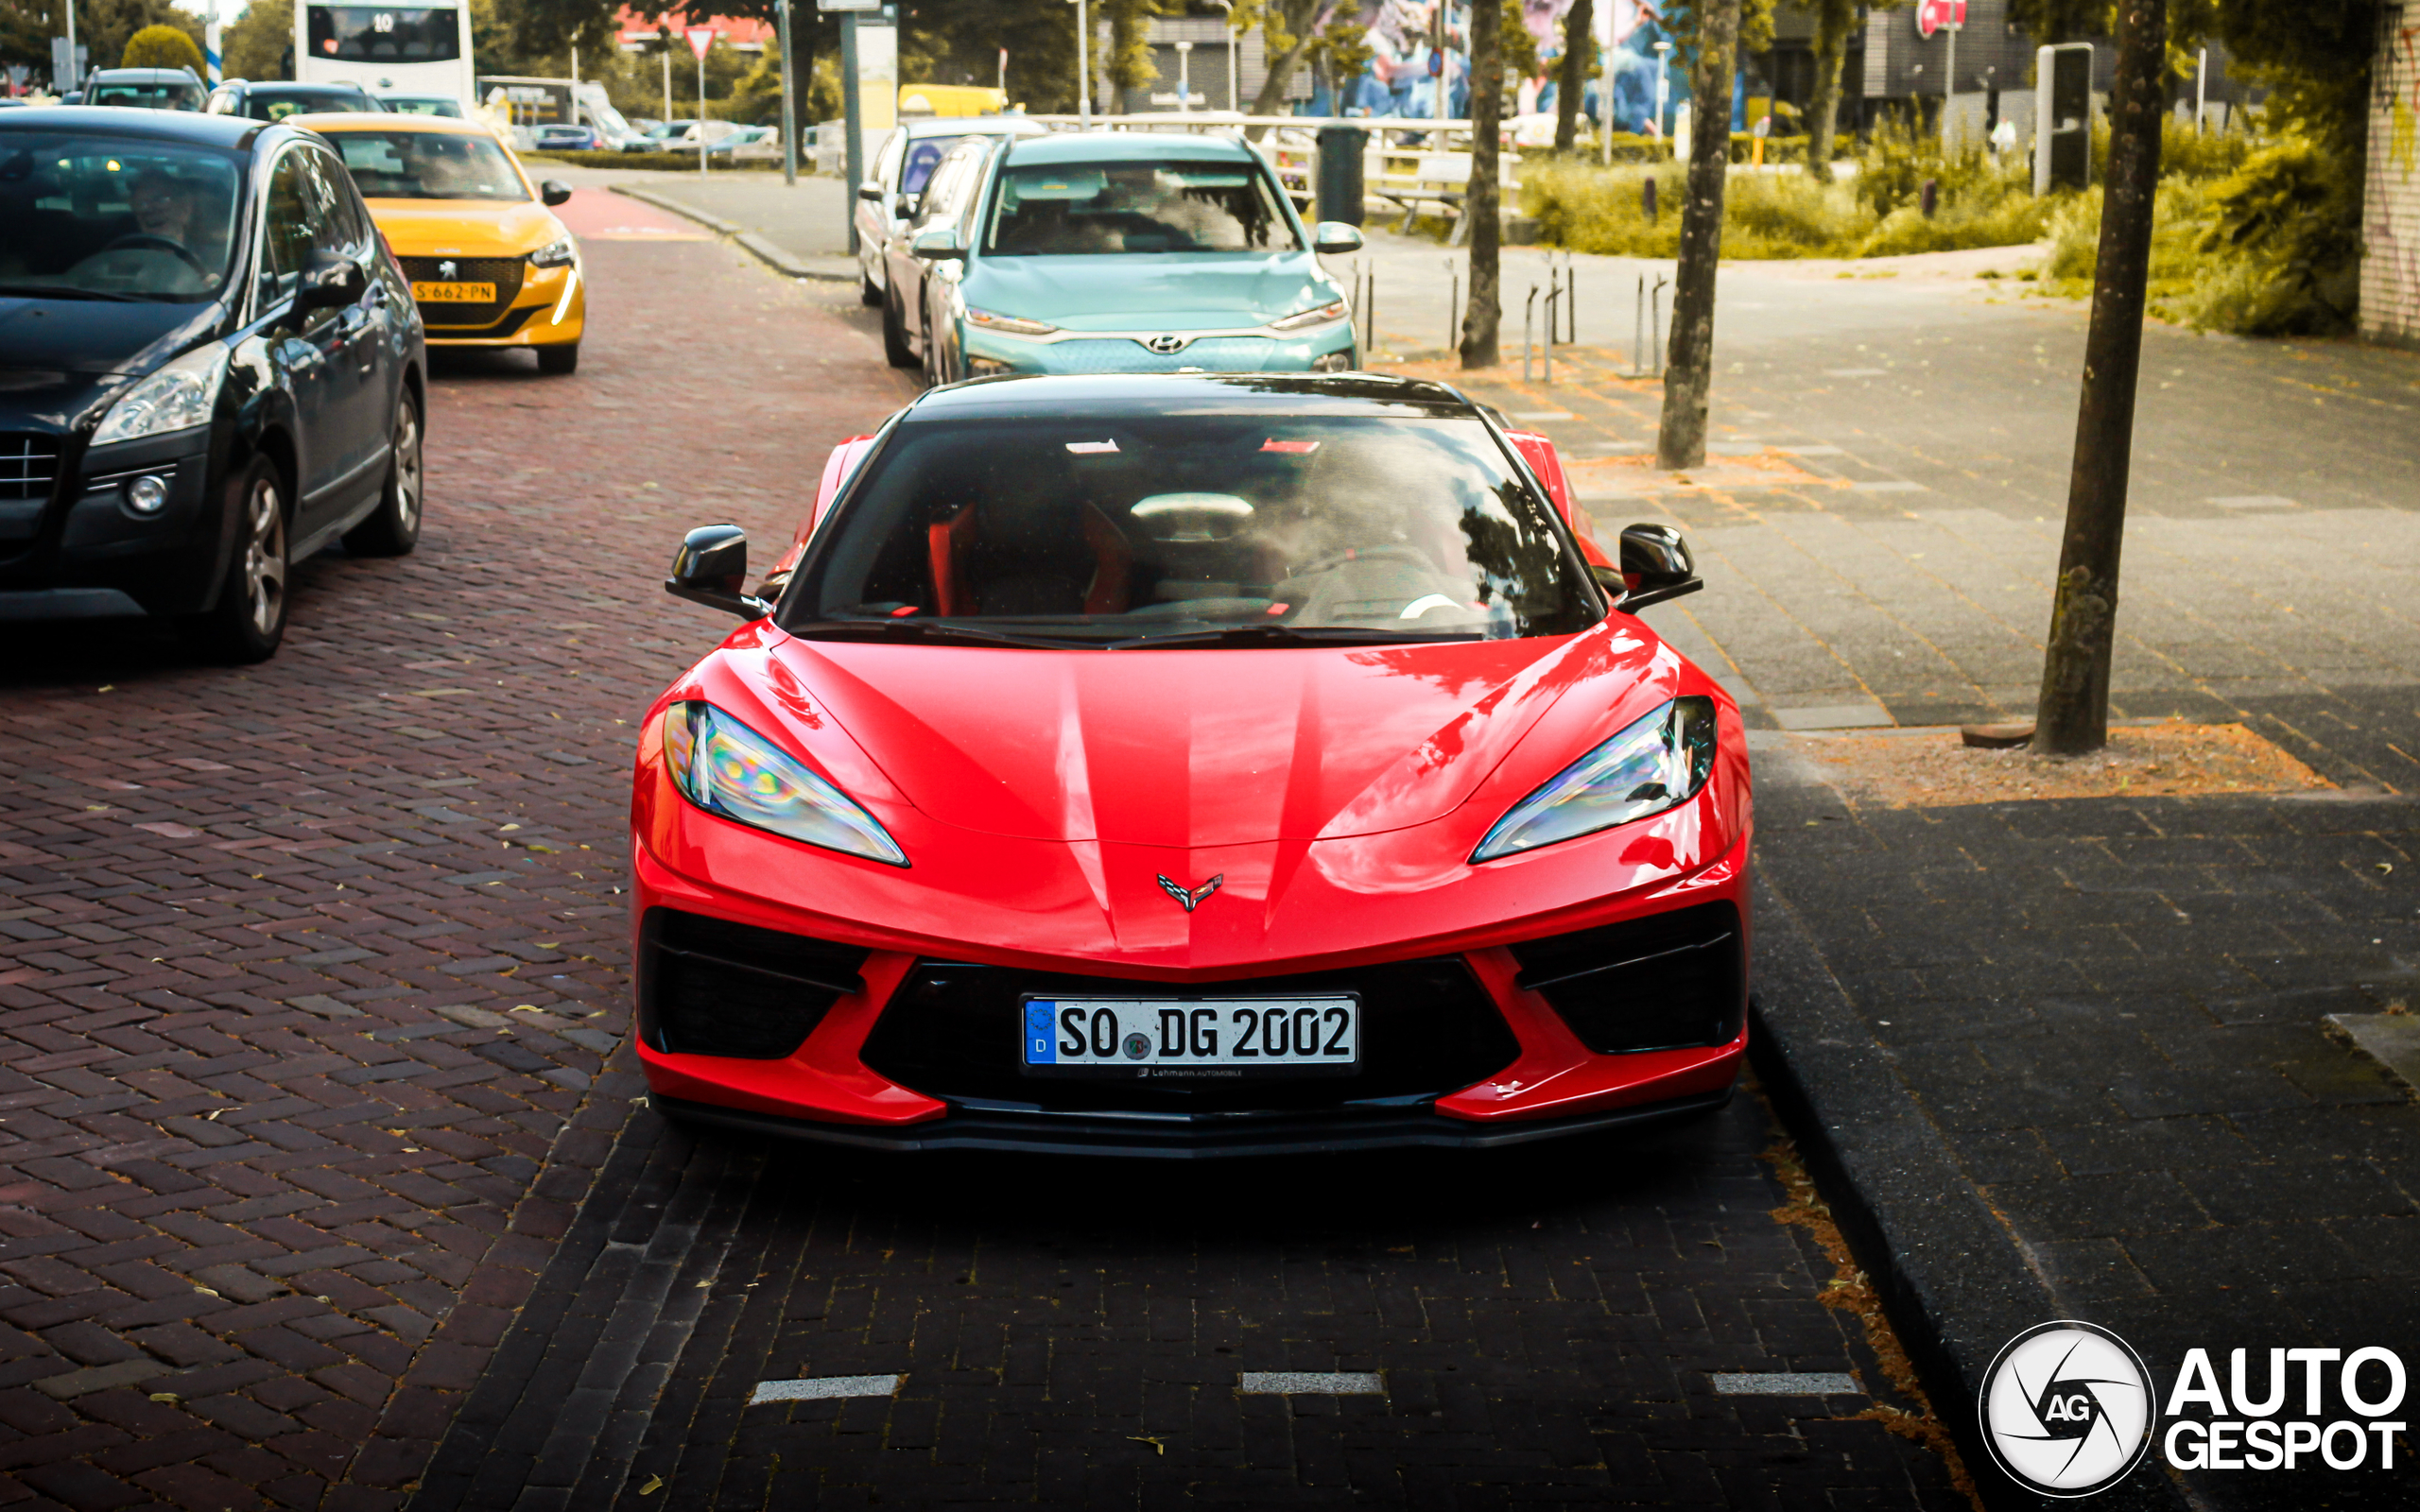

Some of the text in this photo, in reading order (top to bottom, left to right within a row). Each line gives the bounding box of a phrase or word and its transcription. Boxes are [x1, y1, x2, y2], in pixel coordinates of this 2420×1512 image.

[374, 13, 393, 33] 10
[416, 284, 491, 299] S-662-PN
[1059, 1007, 1350, 1057] SO DG 2002
[1035, 1040, 1046, 1053] D
[1152, 1069, 1195, 1077] Lehmann
